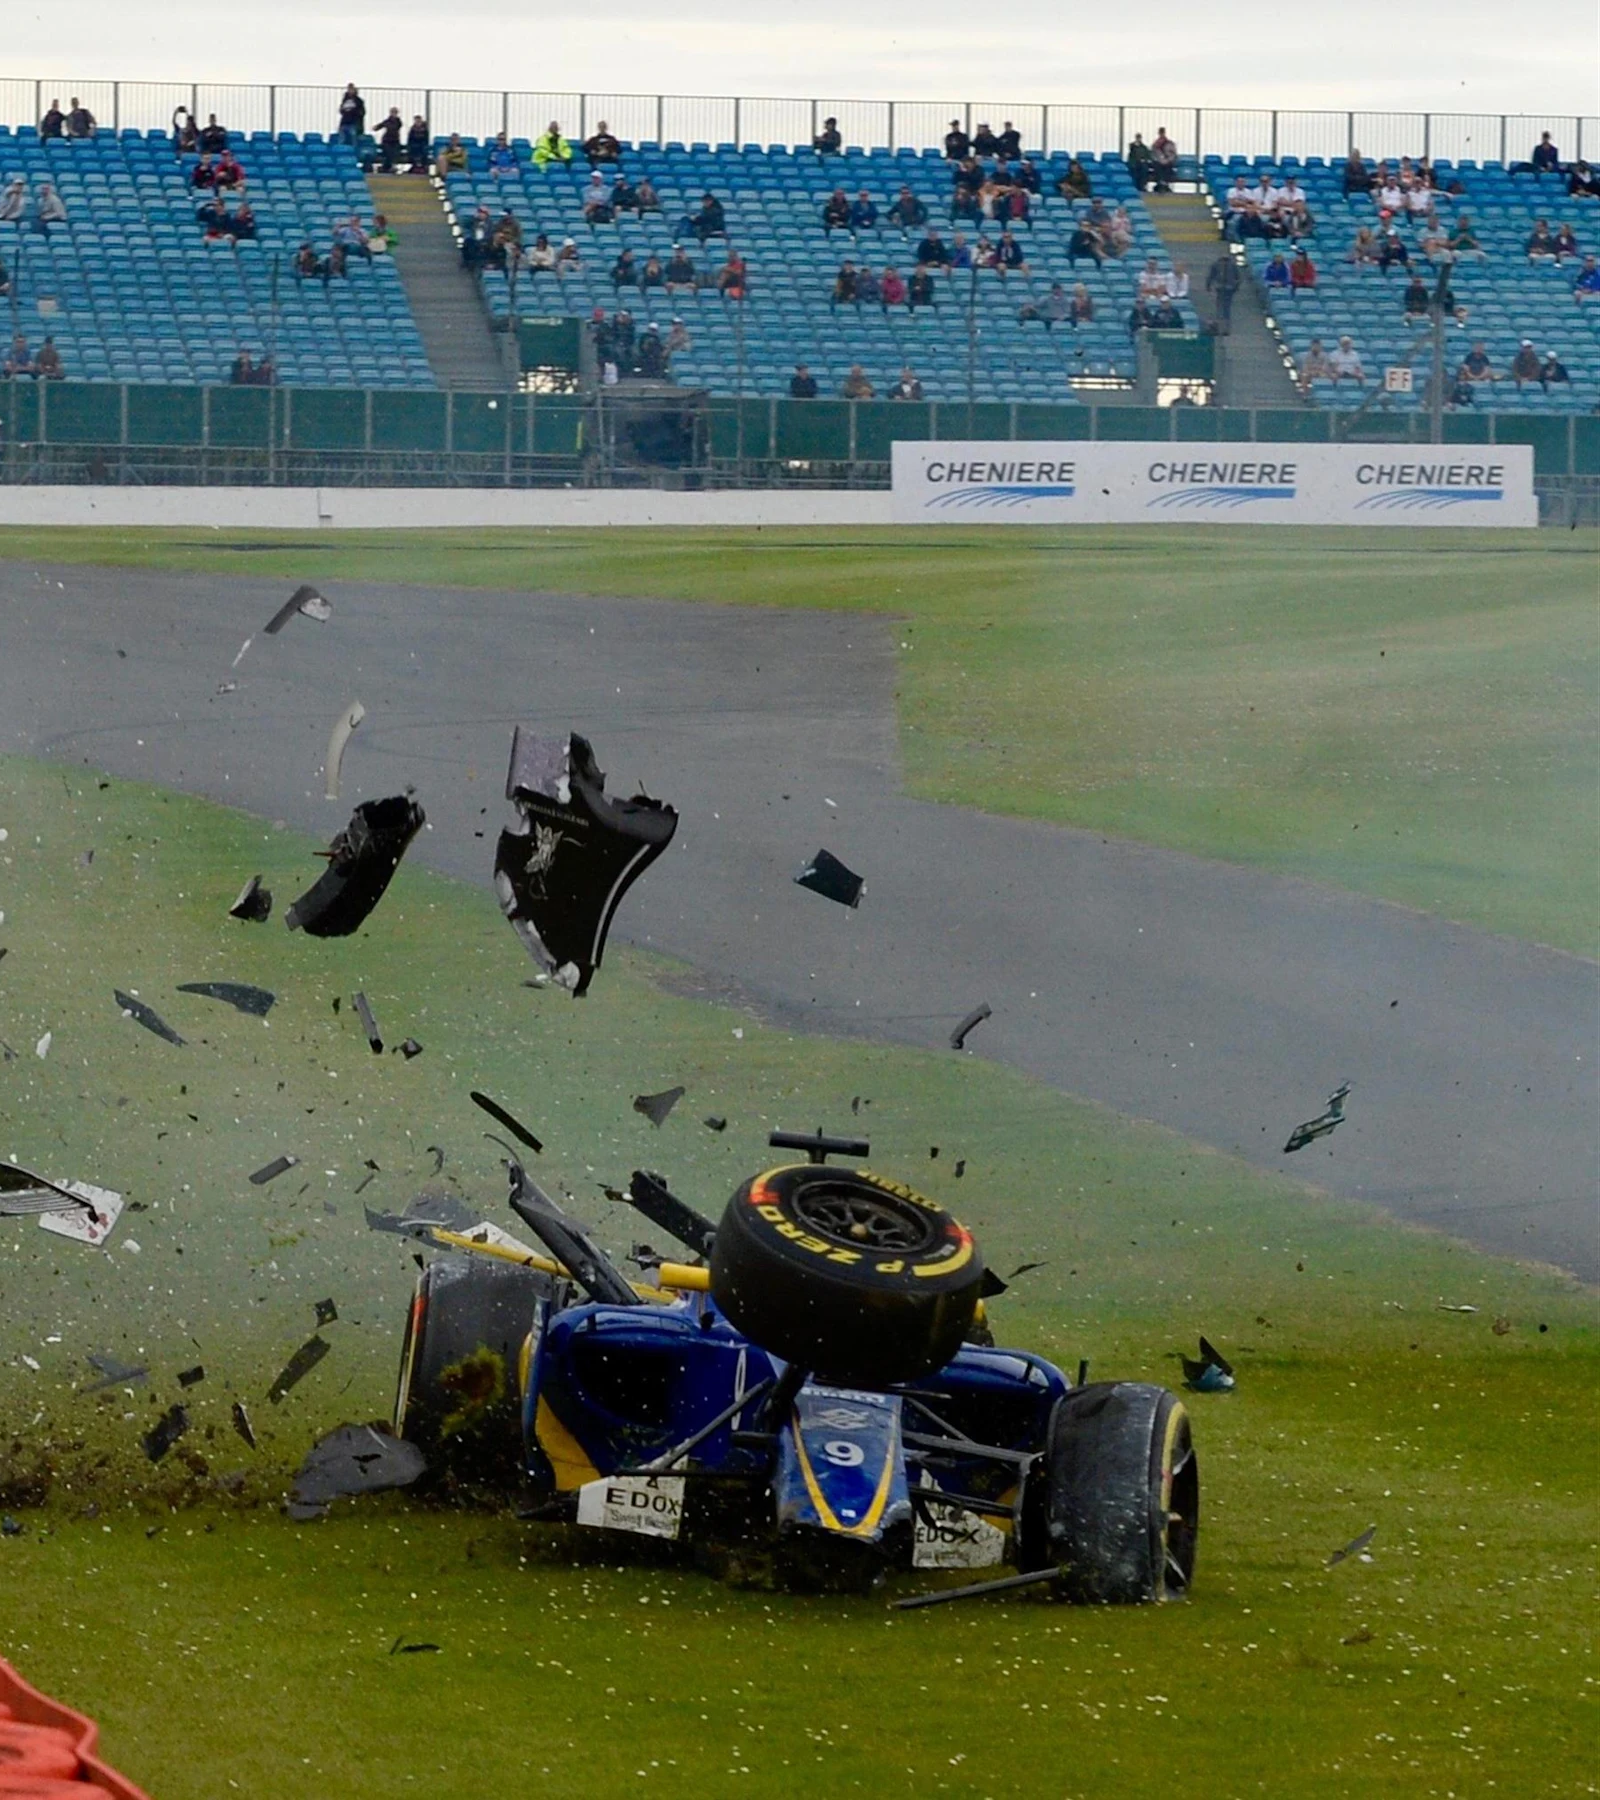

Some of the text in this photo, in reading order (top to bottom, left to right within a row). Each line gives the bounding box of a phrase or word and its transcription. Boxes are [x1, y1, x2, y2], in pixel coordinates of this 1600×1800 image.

[926, 462, 1076, 482] CHENIERE
[1148, 462, 1297, 484] CHENIERE
[1356, 464, 1505, 486] CHENIERE
[756, 1205, 905, 1273] P ZERO
[824, 1440, 865, 1467] 9
[606, 1487, 681, 1516] EDOX
